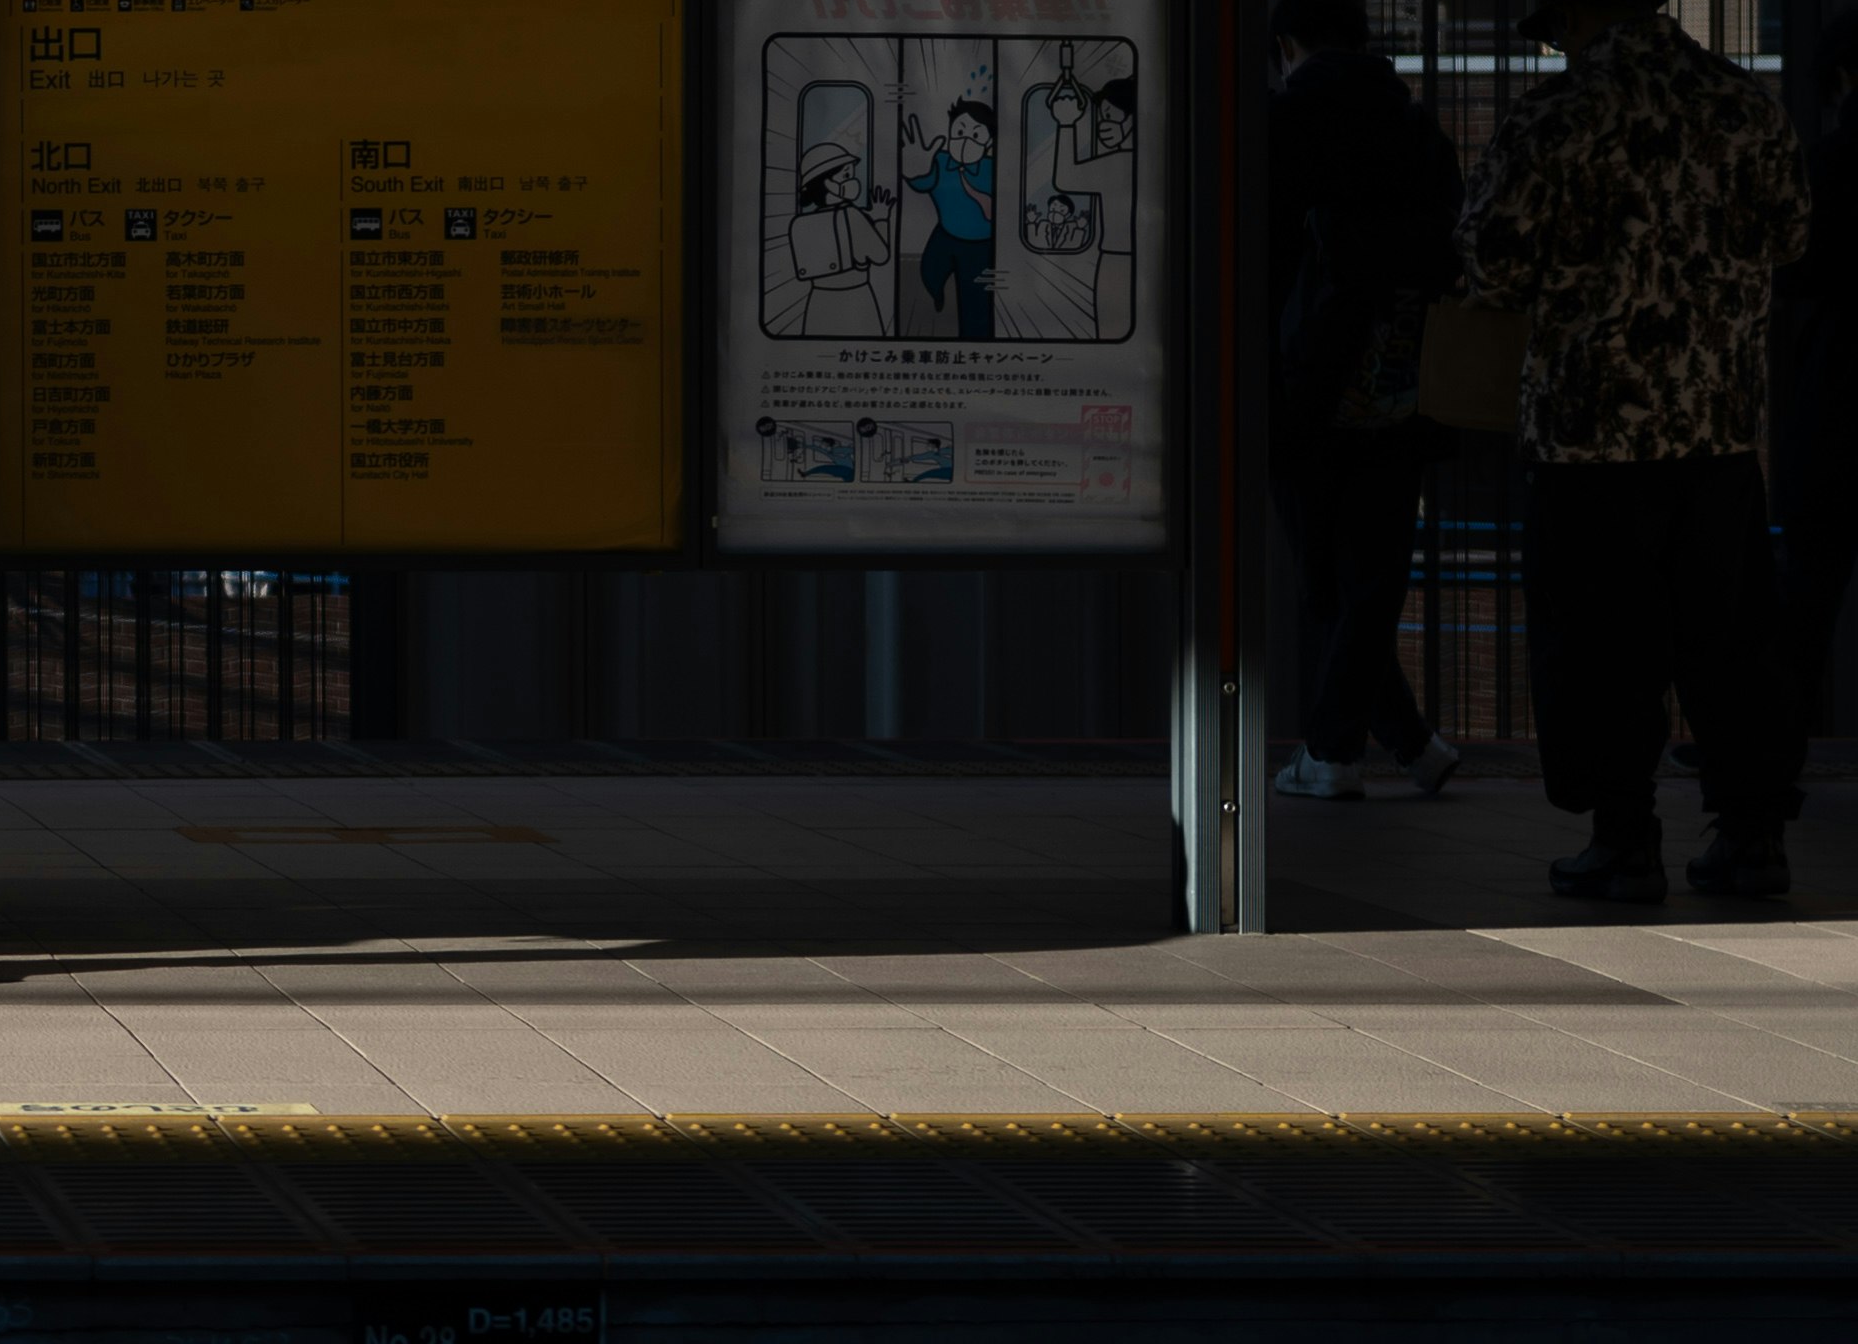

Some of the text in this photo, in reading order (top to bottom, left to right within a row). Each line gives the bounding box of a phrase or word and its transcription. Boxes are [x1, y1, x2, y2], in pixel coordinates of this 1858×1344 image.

[30, 26, 101, 62] 出口
[30, 70, 71, 89] Exit
[88, 70, 124, 88] 出口
[143, 70, 225, 88] 나가는 곳
[31, 142, 91, 171] 北口
[351, 140, 410, 170] 南口
[32, 178, 121, 194] North Exit
[136, 178, 182, 192] 北出口
[351, 177, 444, 192] South Exit
[458, 177, 504, 192] 南出口
[70, 211, 105, 226] バス
[127, 211, 154, 219] TAXI
[163, 211, 232, 226] タクシー
[390, 209, 423, 225] バス
[447, 209, 474, 217] TAXI
[484, 209, 553, 224] タクシー
[70, 231, 91, 241] Bus
[165, 231, 187, 241] Taxi
[389, 229, 410, 239] Bus
[484, 229, 506, 239] Taxi
[32, 252, 126, 267] 国立市北方面
[166, 251, 244, 267] 高木町方面
[351, 251, 444, 266] 国立市東方面
[501, 250, 579, 265] 郵政研修所
[32, 285, 94, 302] 光町方面
[166, 285, 244, 300] 若葉町方面
[351, 285, 444, 300] 国立市西方面
[501, 285, 596, 300] 芸術小ホール
[33, 320, 110, 335] 富士本方面
[166, 319, 228, 334] 鉄道総研
[351, 318, 445, 333] 国立市中方面
[33, 353, 95, 368] 西町方面
[167, 352, 255, 367] ひかりプラザ
[351, 352, 444, 367] 富士見台方面
[839, 349, 1053, 365] かけこみ乗車防止キャンペーン
[33, 386, 110, 402] 日吉町方面
[351, 385, 413, 401] 内藤方面
[33, 419, 95, 435] 戸倉方面
[351, 419, 445, 434] 一橋大学方面
[33, 452, 95, 468] 新町方面
[351, 453, 429, 468] 国立市役所
[468, 1307, 594, 1338] D=1,485
